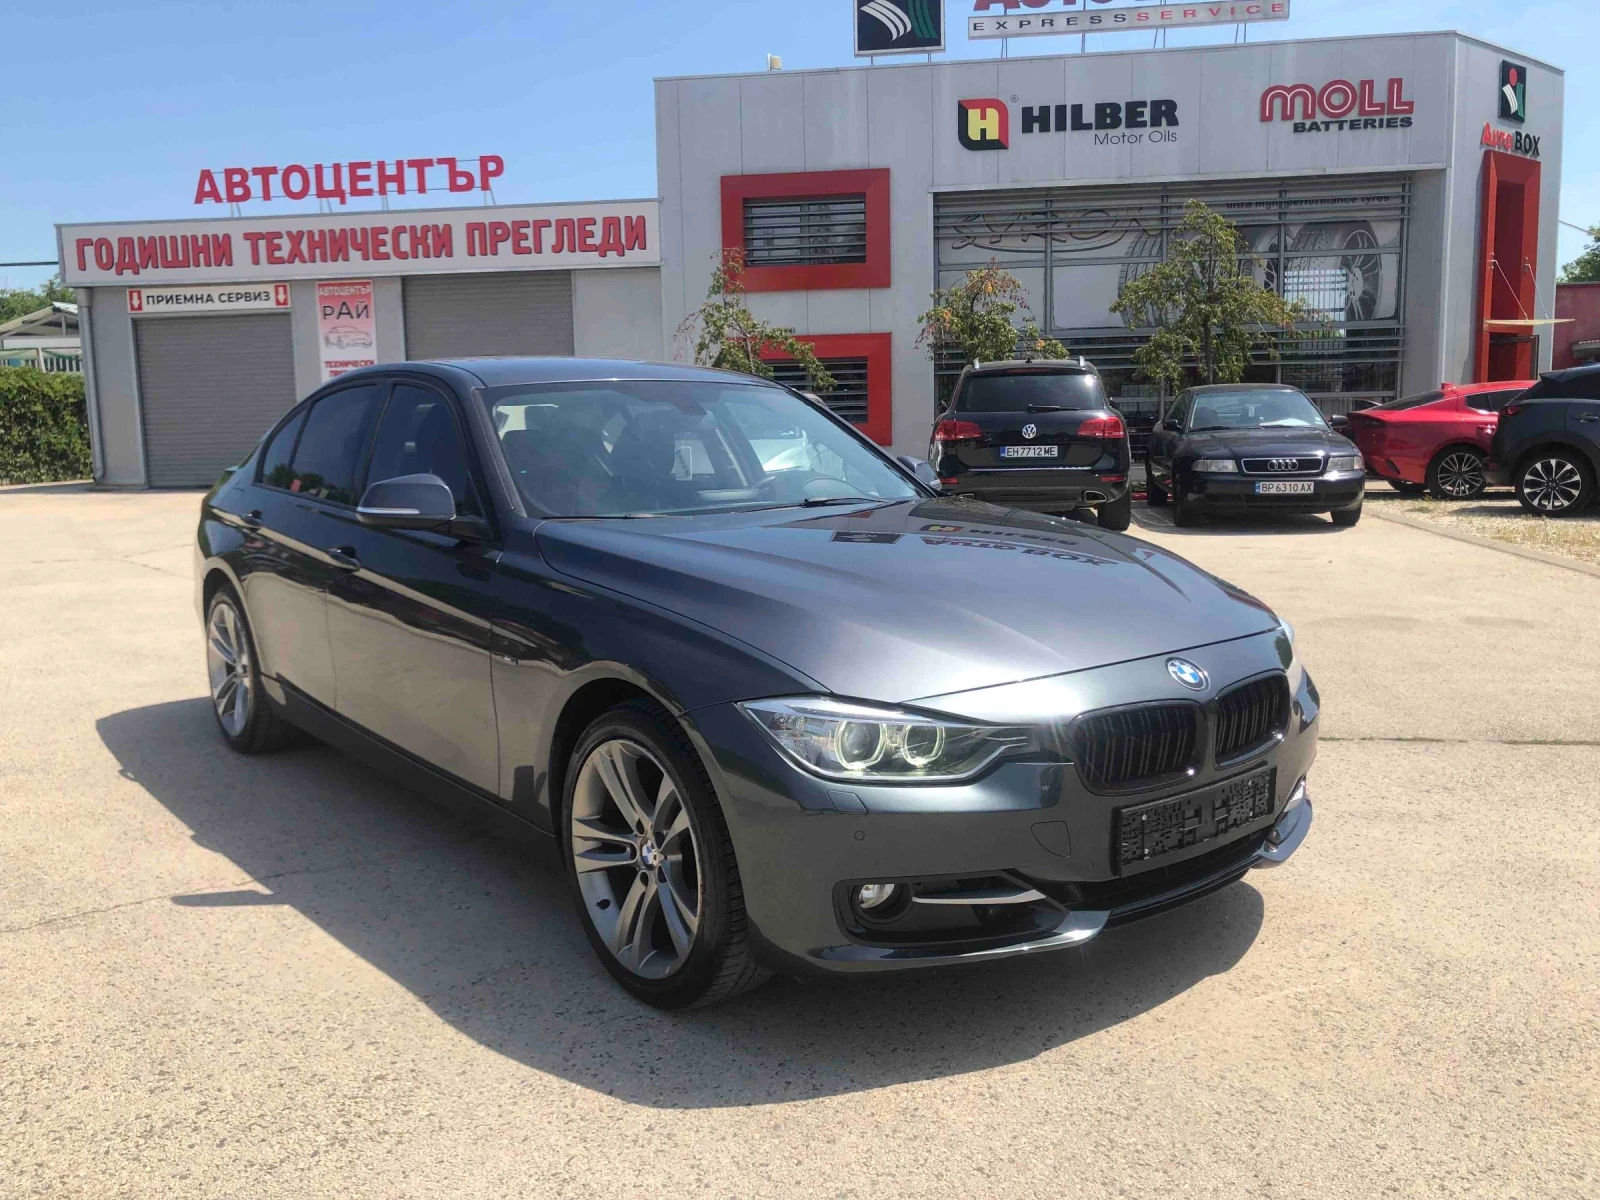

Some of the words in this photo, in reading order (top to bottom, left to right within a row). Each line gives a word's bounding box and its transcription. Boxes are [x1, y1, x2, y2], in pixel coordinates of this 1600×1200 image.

[1022, 99, 1179, 134] HILBER
[1293, 116, 1413, 133] BATTERIES
[1094, 131, 1143, 145] Motor
[1149, 129, 1178, 143] Oils
[194, 155, 504, 204] АВТОЦЕНТЪР
[76, 233, 233, 275] ГОДИШНИ
[243, 224, 453, 265] ТЕХНИЧЕСКИ
[466, 215, 646, 257] ПРЕГЛЕДИ
[146, 293, 214, 305] ПРИЕМНА
[218, 290, 270, 303] СЕРВИЗ
[322, 300, 370, 320] РАЙ
